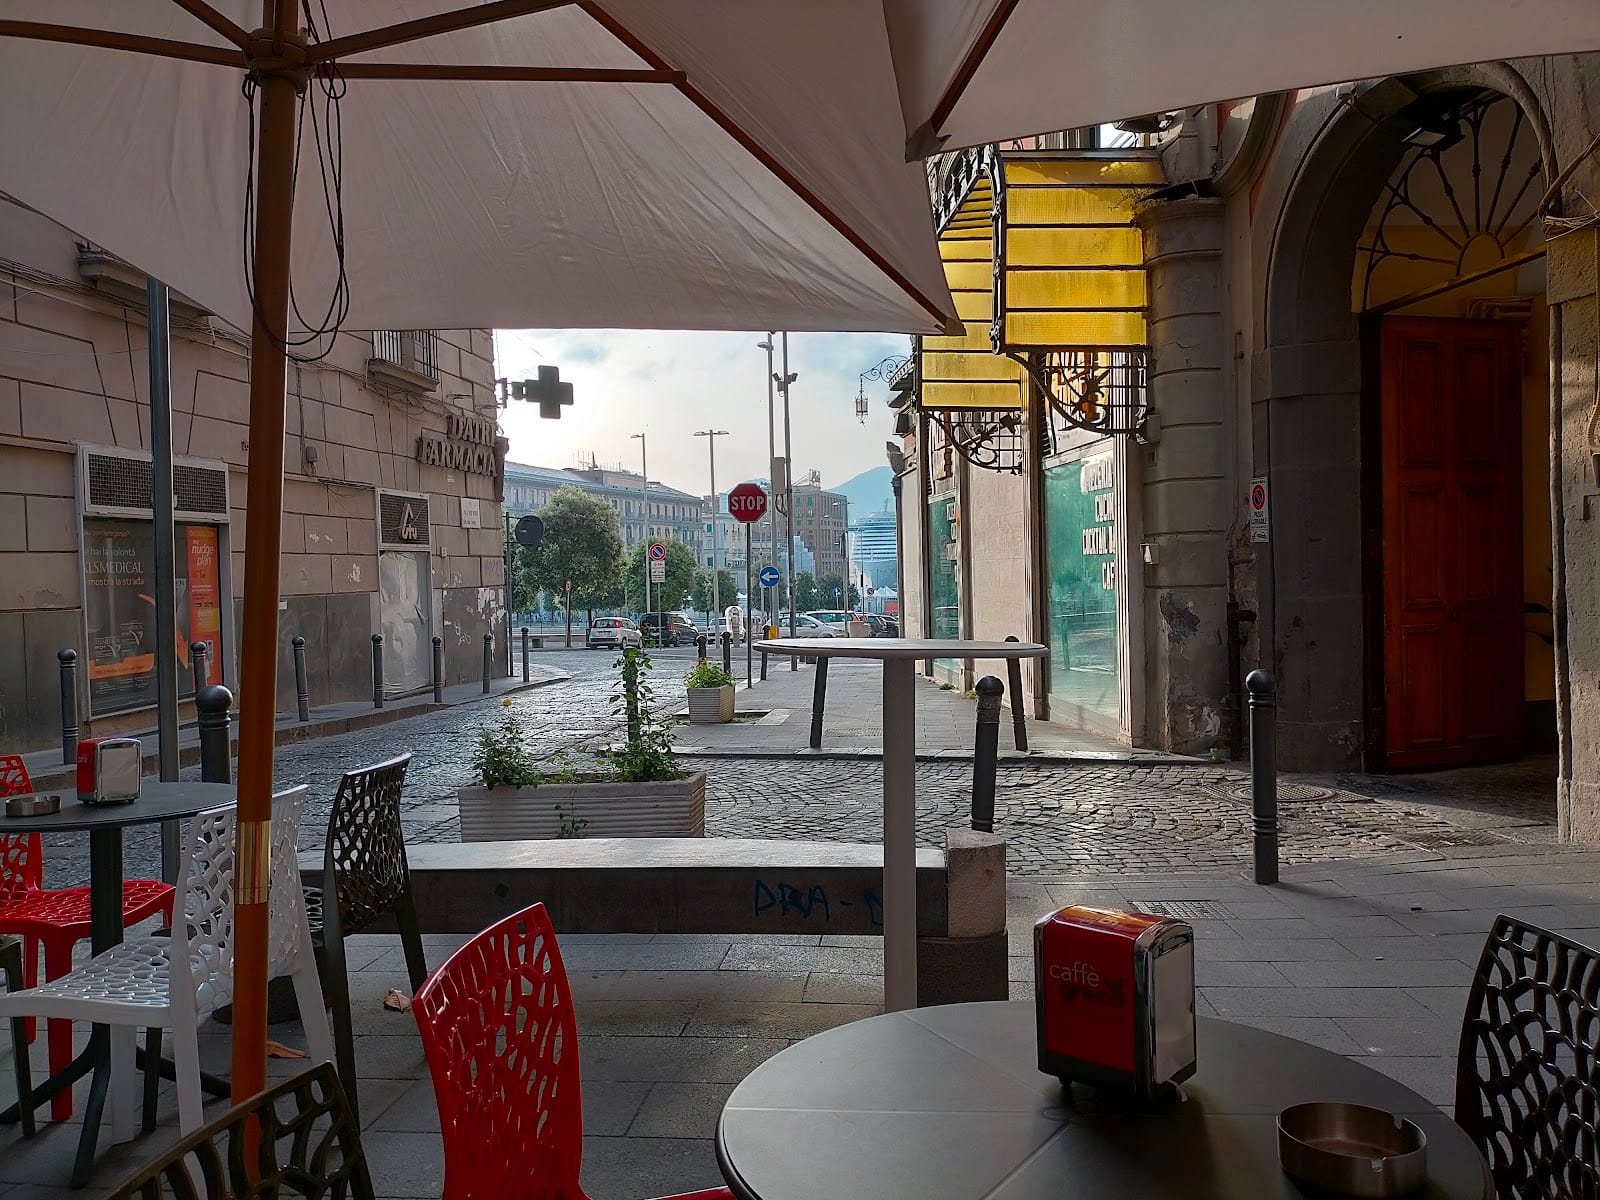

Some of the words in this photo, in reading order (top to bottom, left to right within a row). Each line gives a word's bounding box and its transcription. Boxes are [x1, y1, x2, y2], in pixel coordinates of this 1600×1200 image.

[420, 438, 497, 478] FARMACIA
[731, 495, 765, 511] STOP
[192, 545, 214, 556] nudge
[1050, 961, 1100, 988] caffè
